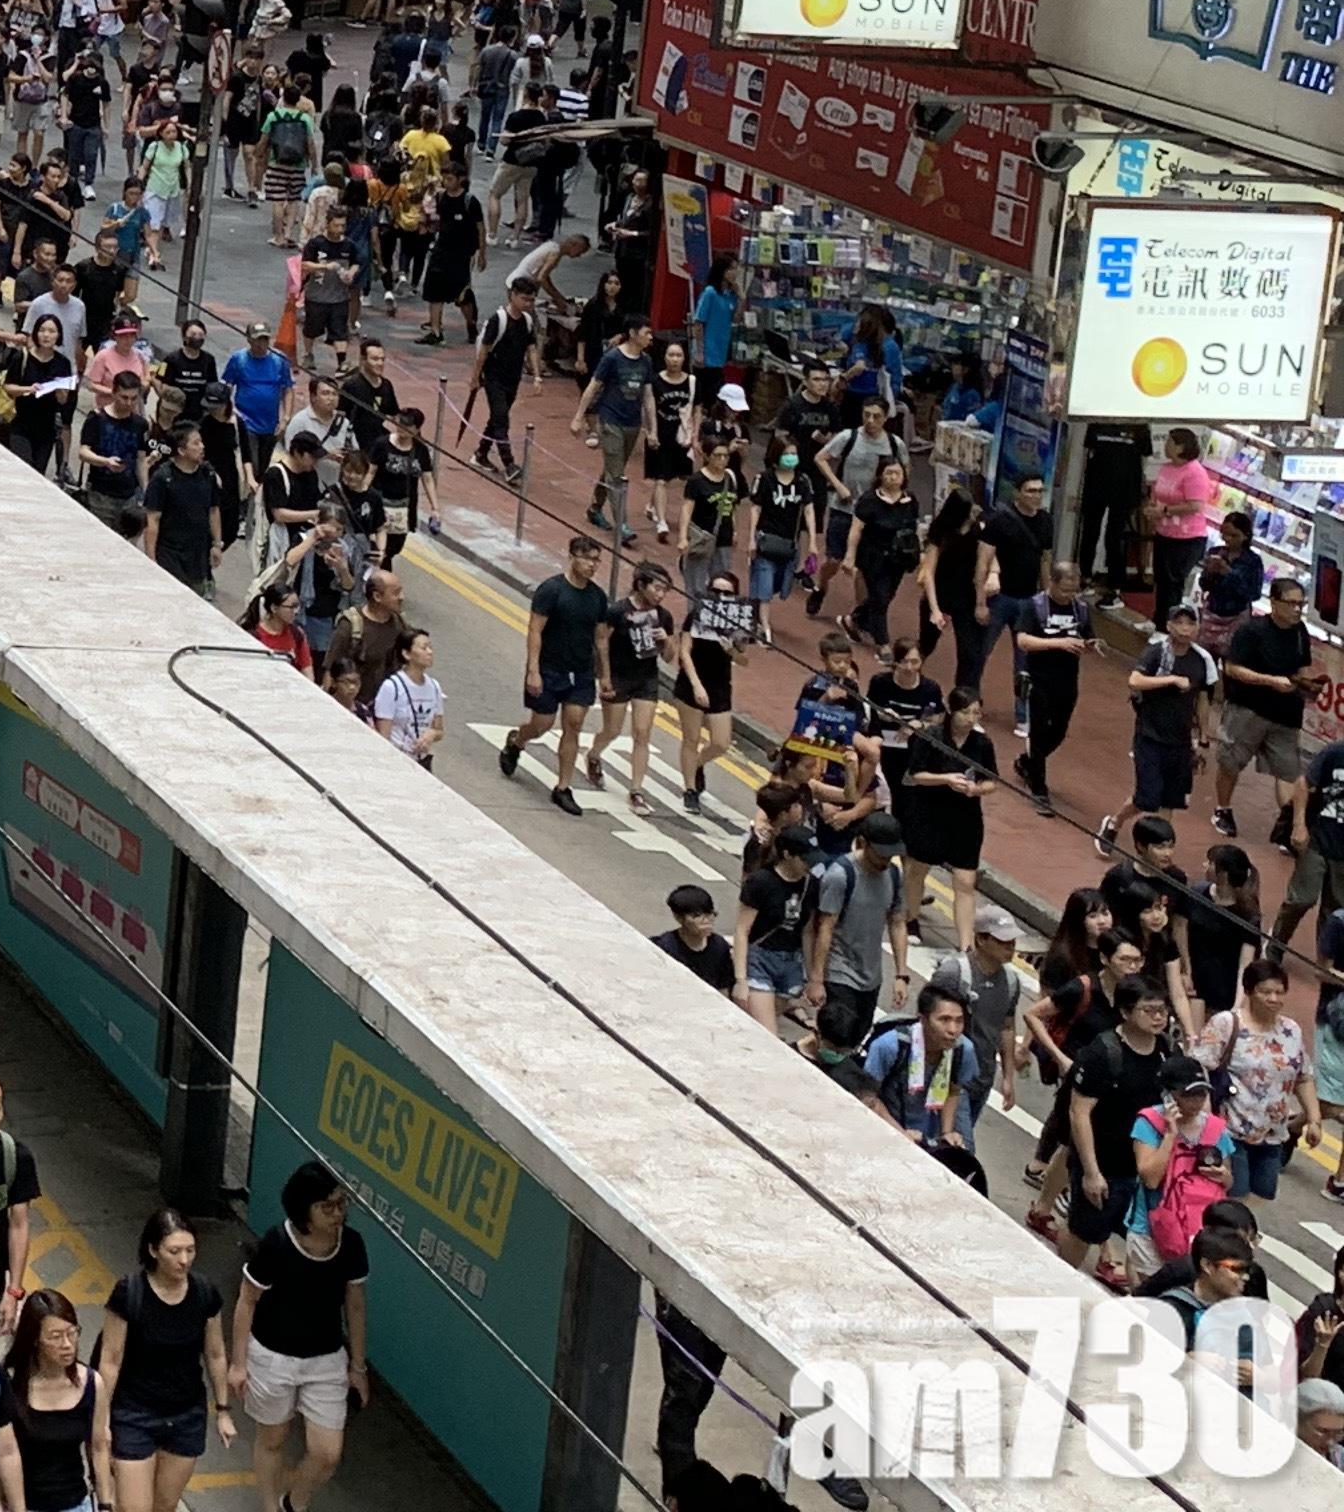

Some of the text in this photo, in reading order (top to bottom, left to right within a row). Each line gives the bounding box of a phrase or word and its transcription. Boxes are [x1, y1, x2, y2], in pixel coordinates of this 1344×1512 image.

[856, 18, 946, 33] MOBILE
[1144, 238, 1294, 262] Telecom Digital
[1141, 264, 1290, 302] 電訊數碼
[1251, 305, 1287, 319] 6033
[1200, 342, 1307, 378] SUN
[1197, 382, 1302, 397] MOBILE
[330, 1059, 415, 1173] GOES
[415, 1116, 508, 1239] LIVE!
